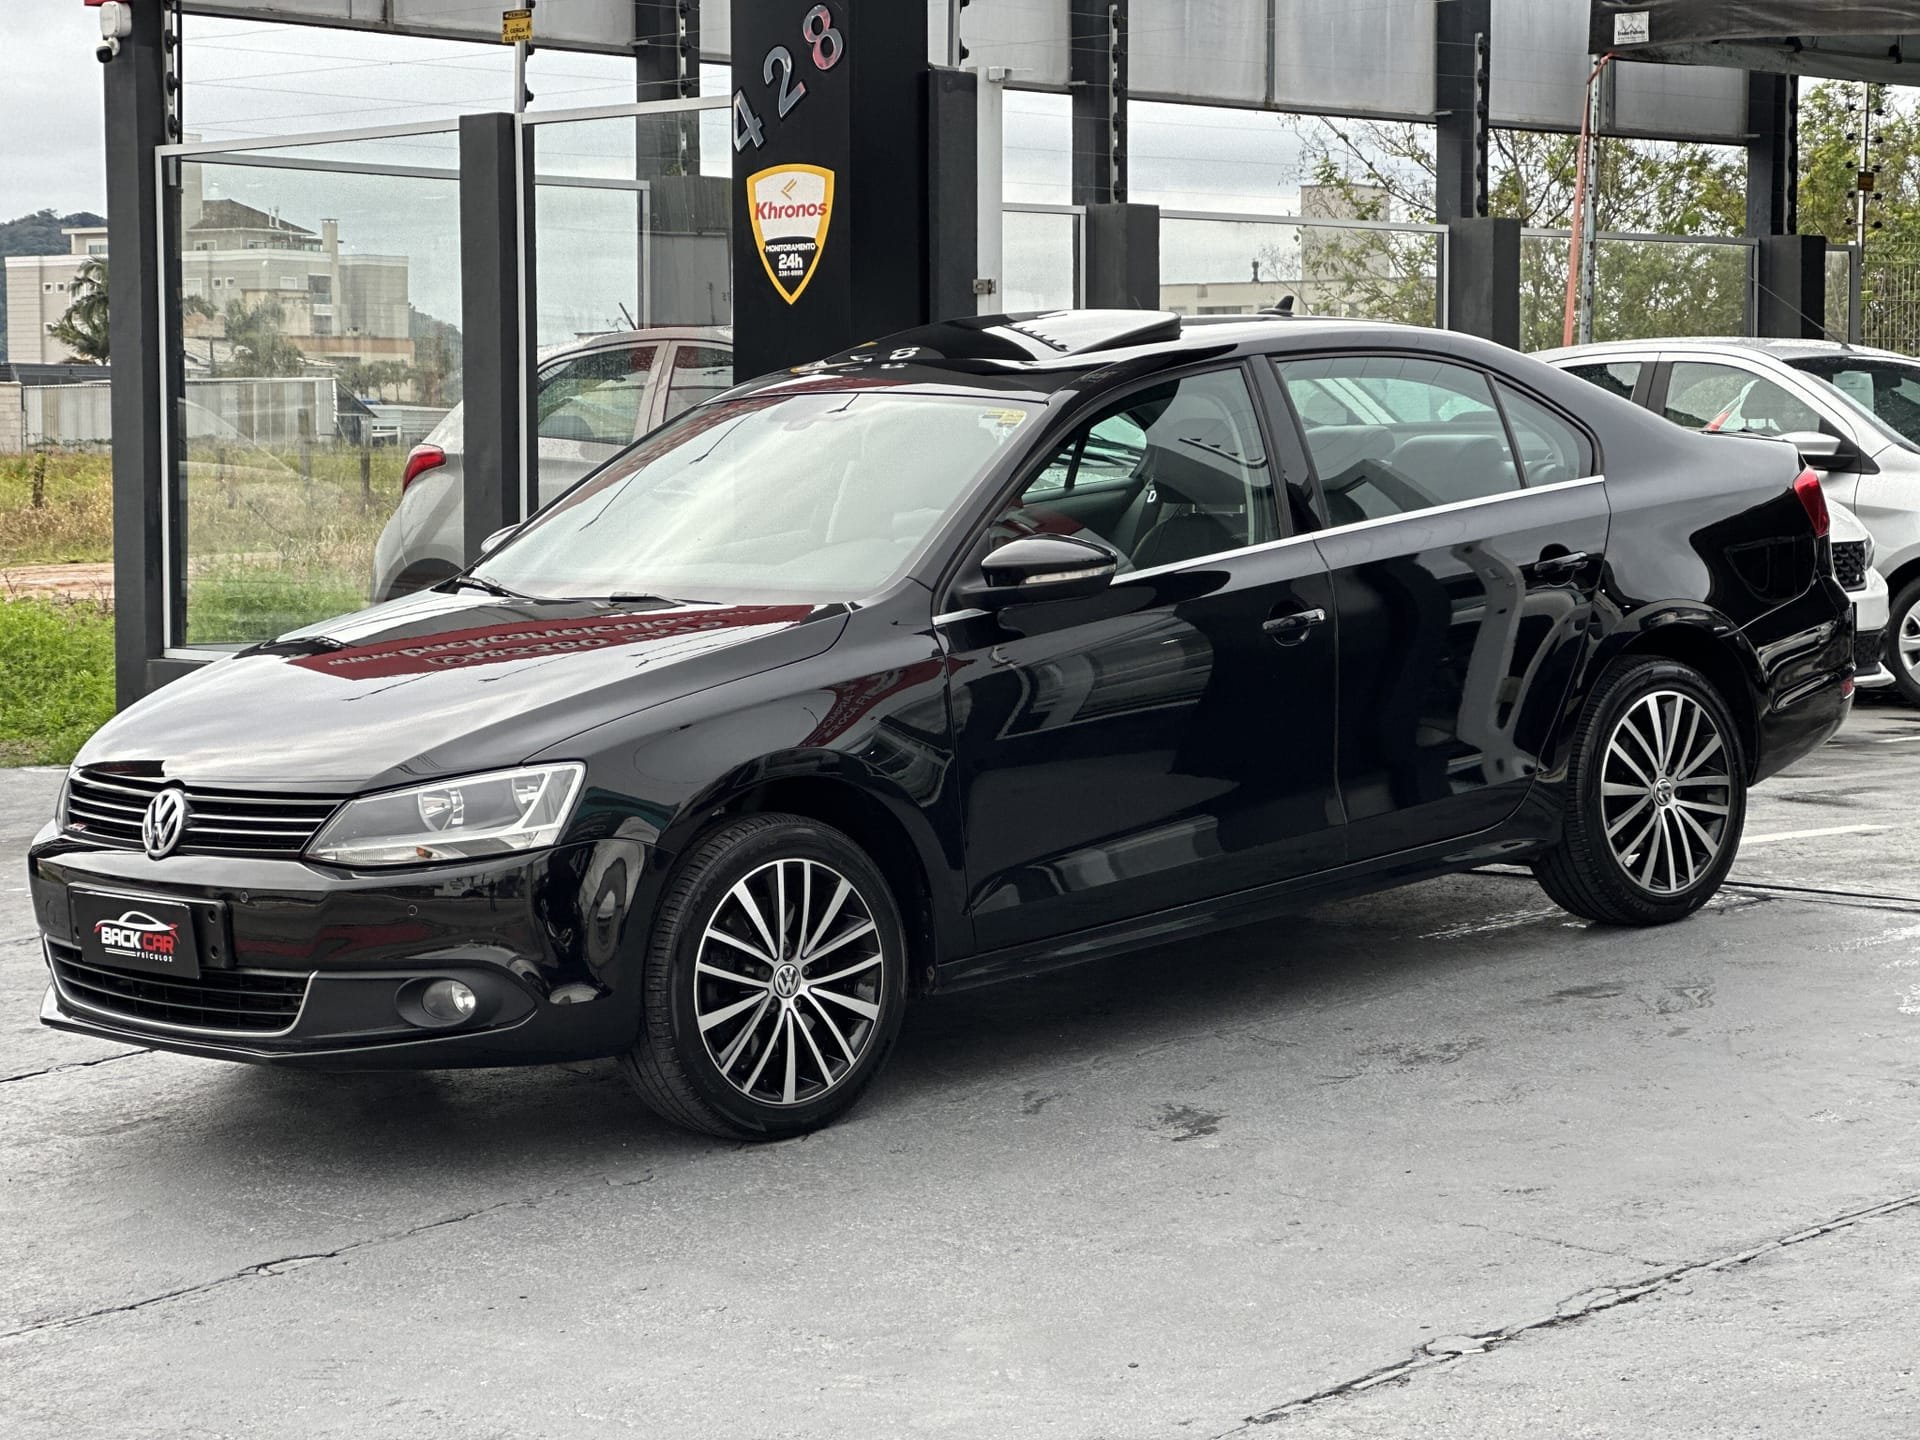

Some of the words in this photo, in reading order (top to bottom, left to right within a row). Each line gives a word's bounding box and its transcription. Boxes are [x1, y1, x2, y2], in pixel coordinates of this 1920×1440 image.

[755, 201, 827, 220] Khronos
[765, 242, 816, 252] MONITORAMENTO
[778, 253, 803, 269] 24h
[101, 926, 142, 949] BACK
[143, 932, 174, 955] CAR
